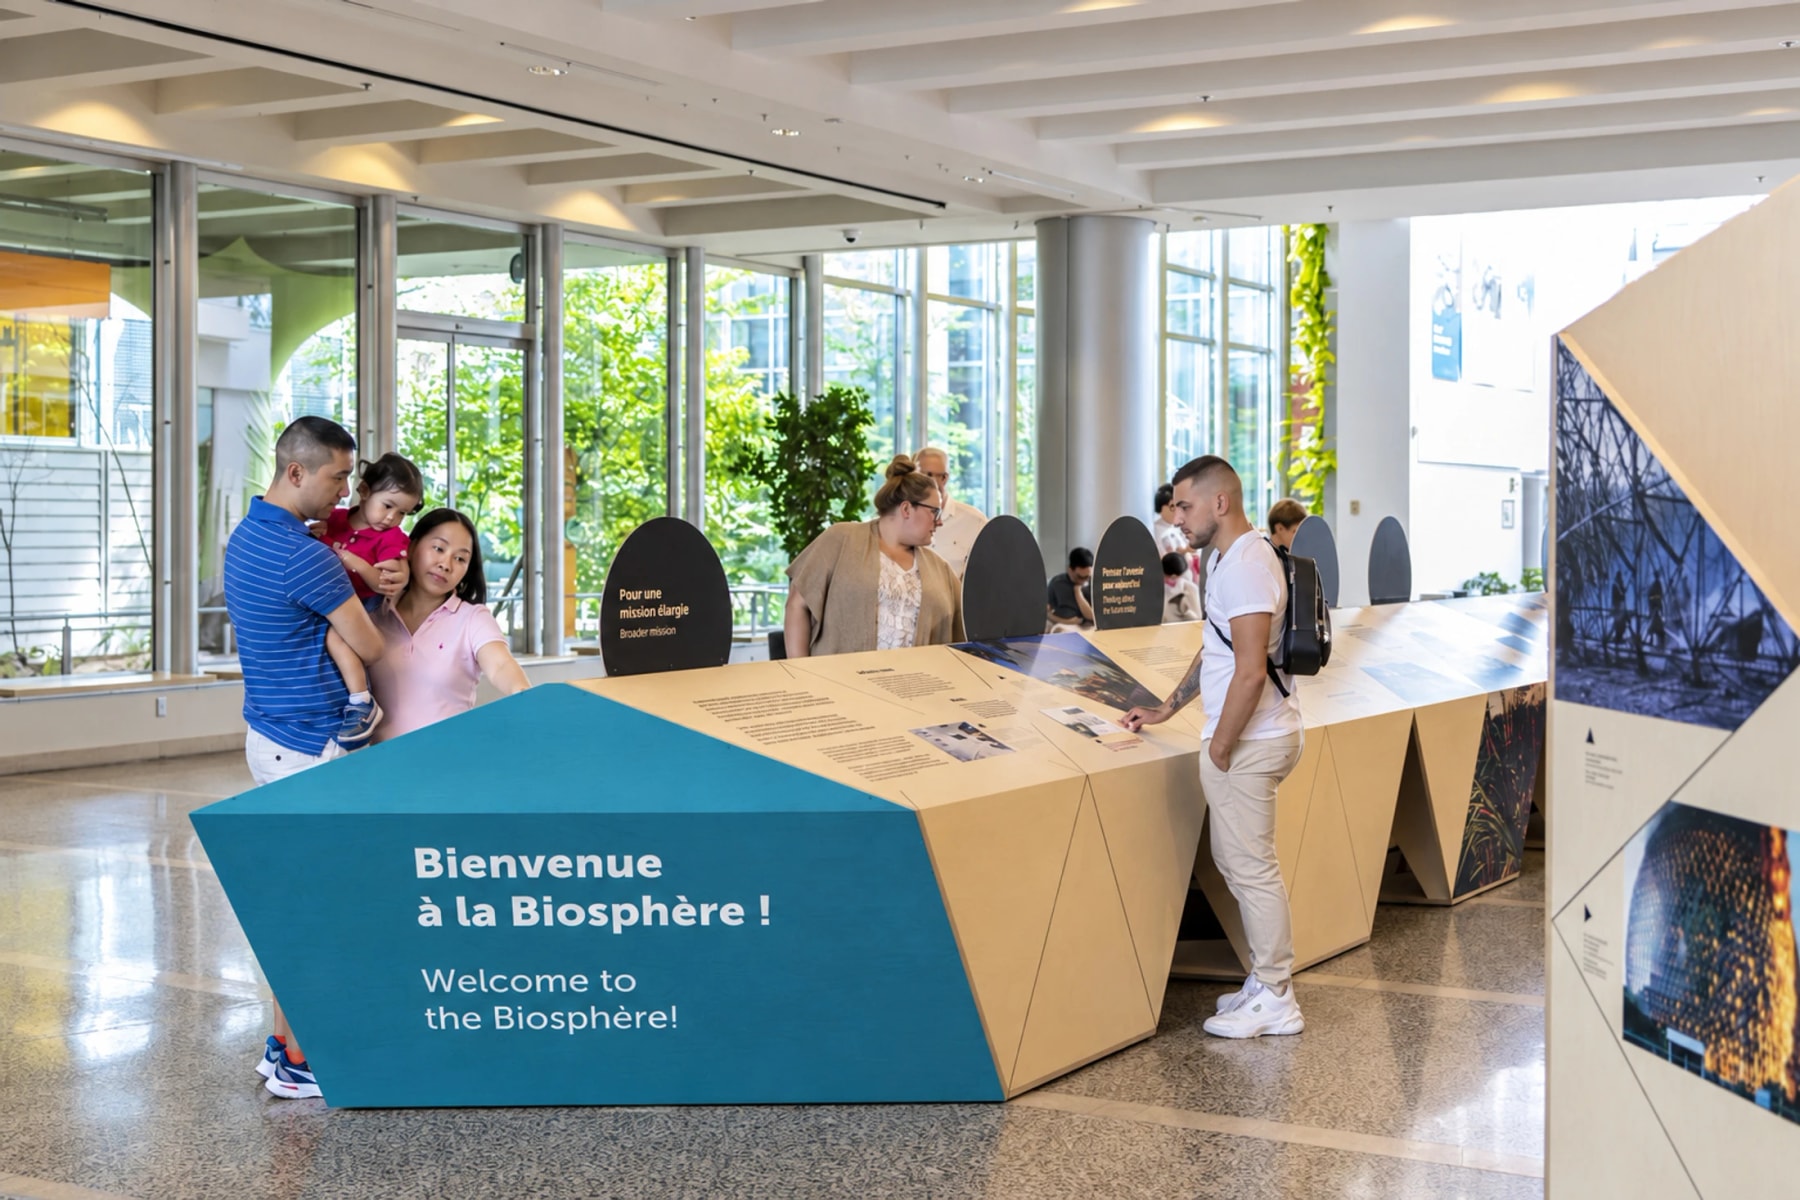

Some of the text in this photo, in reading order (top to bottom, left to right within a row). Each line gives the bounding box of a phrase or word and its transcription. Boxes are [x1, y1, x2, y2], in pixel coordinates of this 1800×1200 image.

[619, 588, 662, 600] Pour une
[619, 603, 689, 619] mission élargie
[620, 625, 677, 639] Broader mission
[414, 847, 663, 879] Bienvenue
[417, 894, 770, 935] à la Biosphère !
[420, 968, 637, 993] Welcome to
[424, 1005, 677, 1035] the Biosphère!
